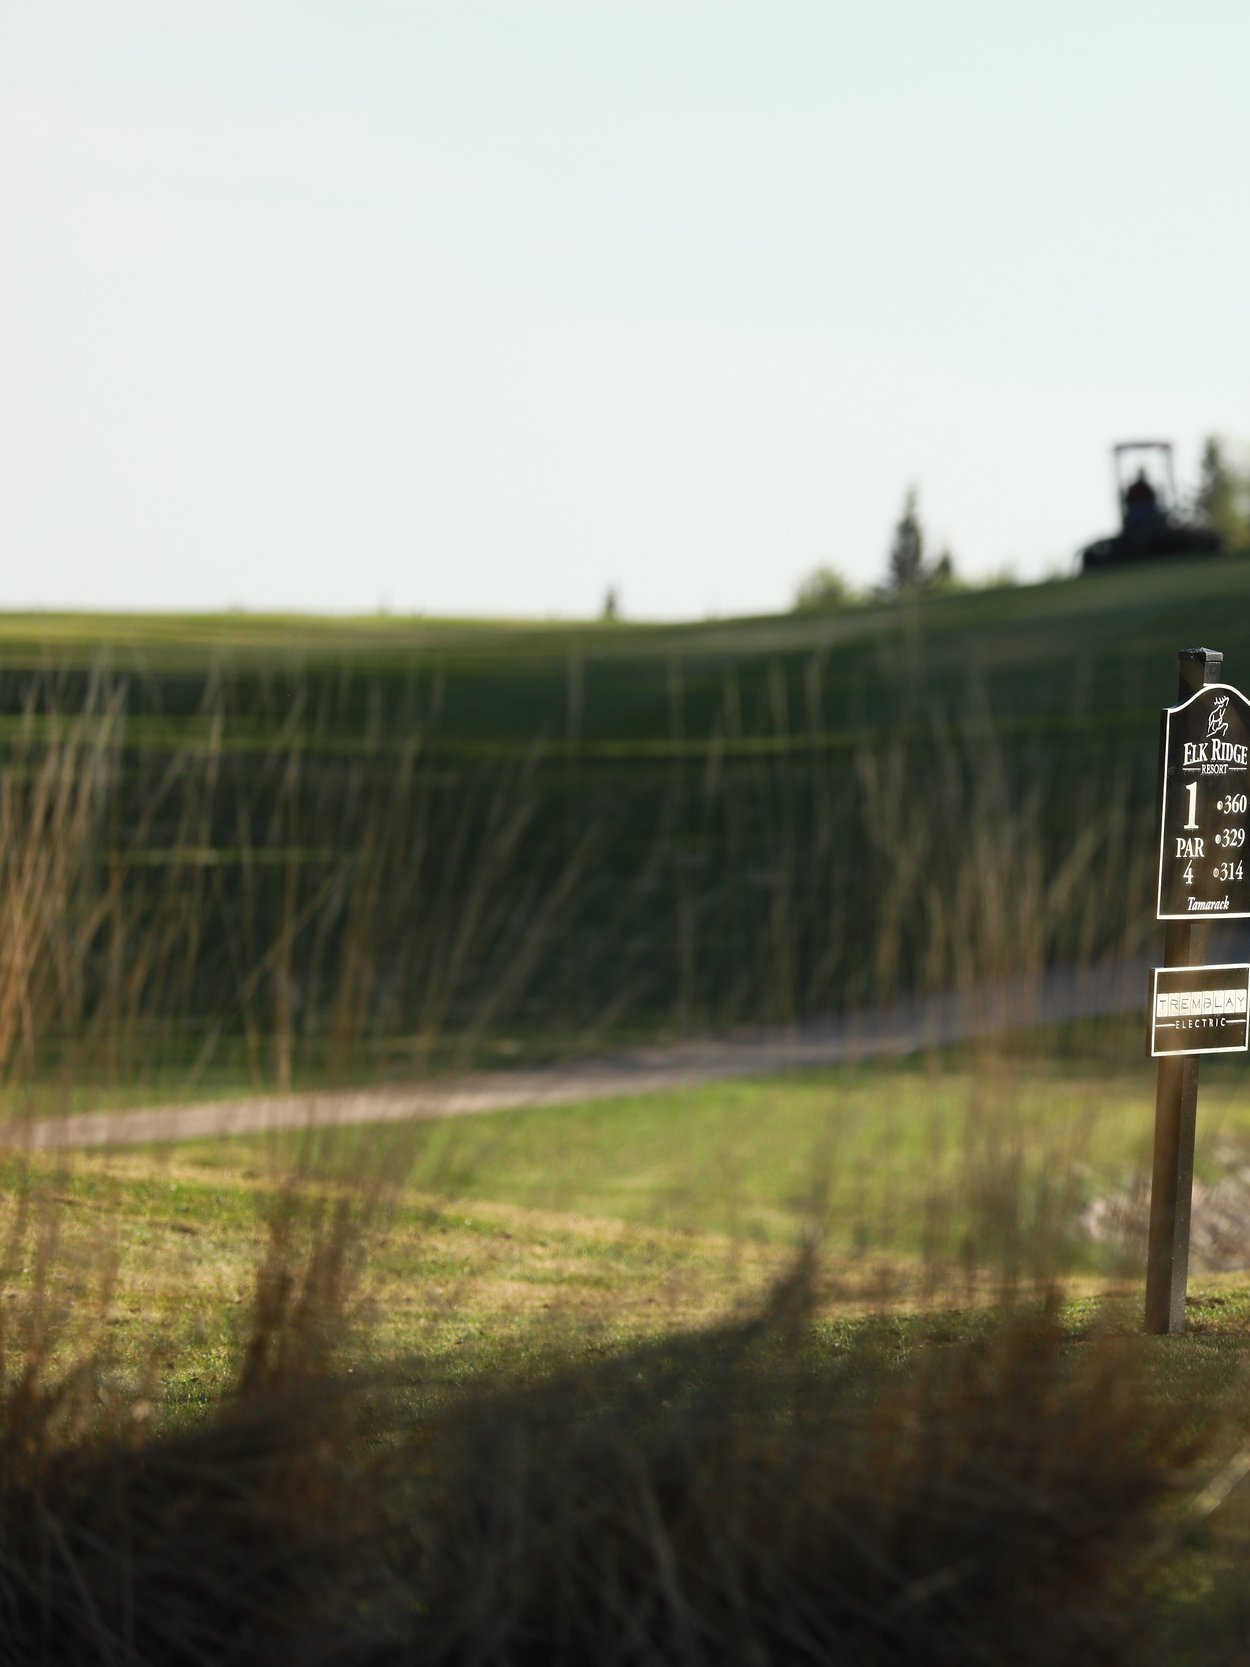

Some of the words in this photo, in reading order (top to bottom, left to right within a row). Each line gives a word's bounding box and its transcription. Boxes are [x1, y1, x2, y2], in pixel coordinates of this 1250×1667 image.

[1183, 741, 1209, 765] ELK
[1211, 738, 1248, 765] RIDGE
[1201, 764, 1228, 774] RESORT
[1184, 781, 1199, 829] 1
[1224, 793, 1248, 814] 360
[1176, 837, 1204, 858] PAR
[1222, 828, 1246, 848] 329
[1183, 860, 1194, 884] 4
[1219, 860, 1243, 881] 314
[1187, 895, 1230, 911] Tamarack
[1159, 996, 1245, 1011] TREMBLAY
[1175, 1017, 1227, 1029] ELECTRIC
